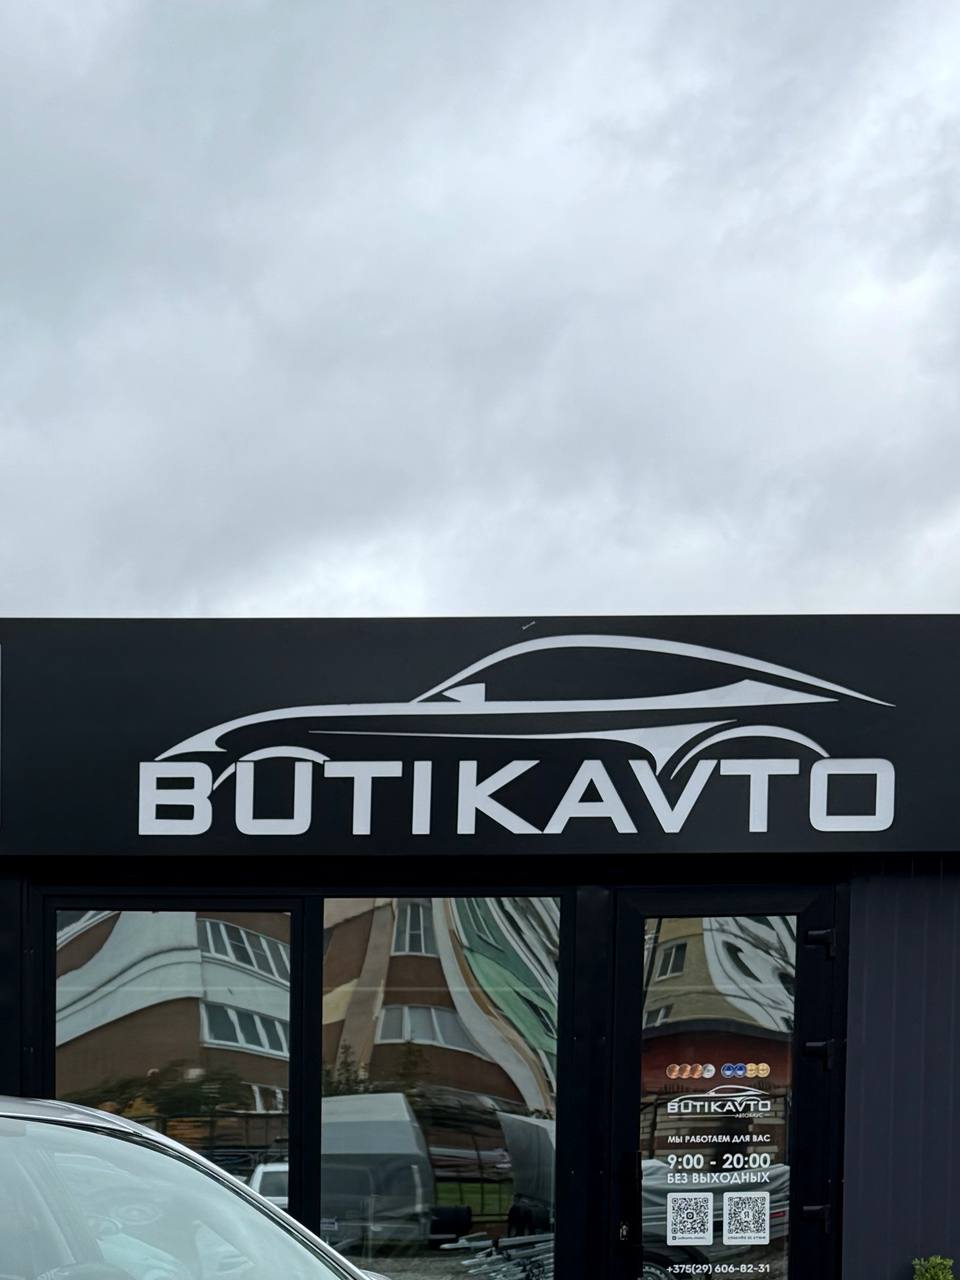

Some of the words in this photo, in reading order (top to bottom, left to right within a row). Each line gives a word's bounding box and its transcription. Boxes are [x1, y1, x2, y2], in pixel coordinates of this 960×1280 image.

[138, 756, 896, 836] BUTIKAVTO
[667, 1101, 771, 1113] BUTIKAVTO
[667, 1134, 683, 1144] МЫ
[685, 1134, 731, 1143] РАБОТАЕМ
[731, 1134, 751, 1143] ДЛЯ
[752, 1133, 771, 1143] ВАС
[667, 1153, 704, 1170] 9:00
[722, 1153, 771, 1169] 20:00
[667, 1173, 689, 1184] БЕЗ
[692, 1172, 770, 1184] ВЫХОДНЫХ
[666, 1263, 713, 1275] +375(29)
[714, 1263, 771, 1273] 606-82-31
